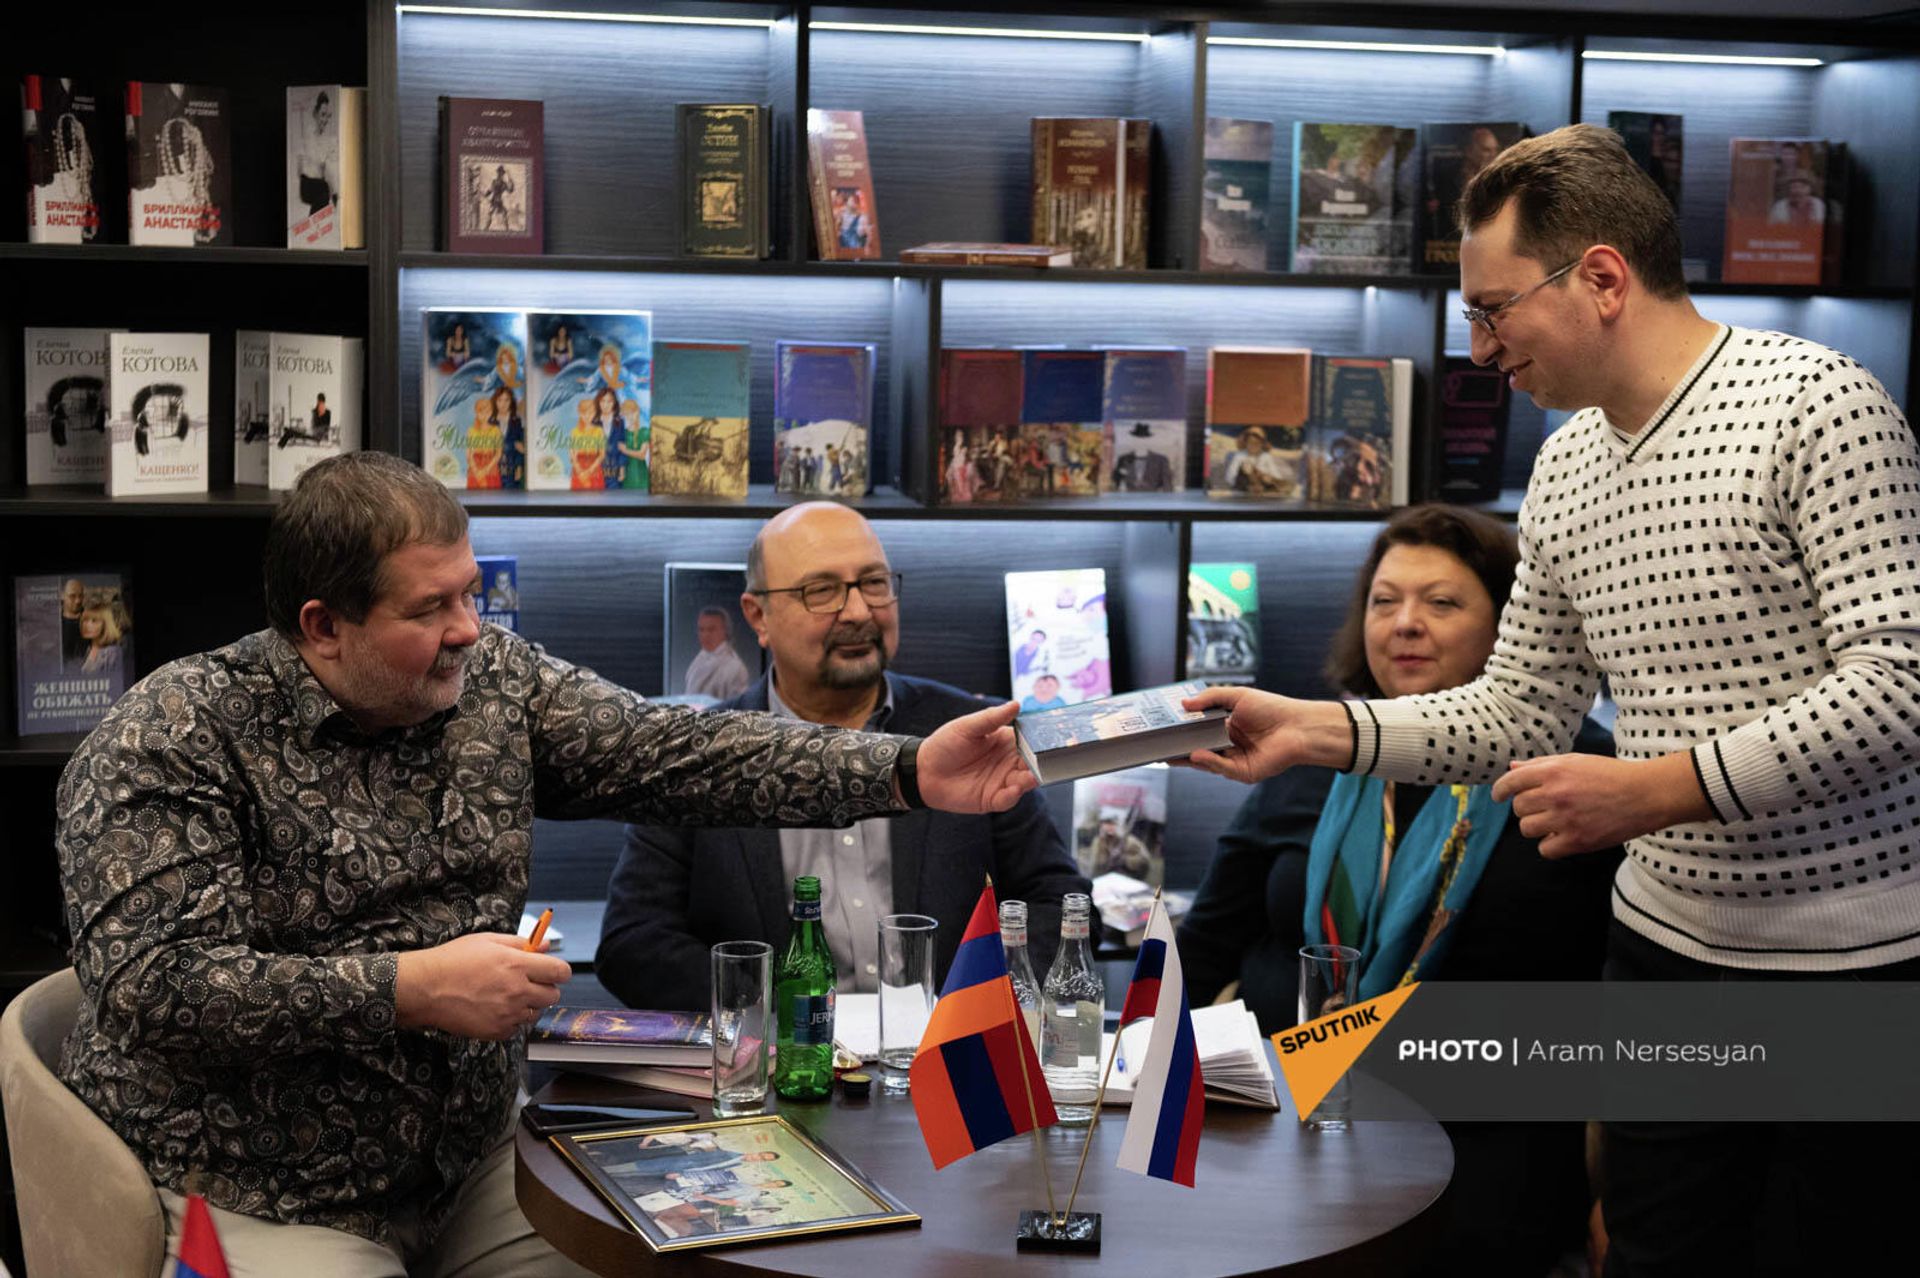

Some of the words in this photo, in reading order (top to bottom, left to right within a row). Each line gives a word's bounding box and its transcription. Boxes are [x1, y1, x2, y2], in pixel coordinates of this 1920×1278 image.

[36, 350, 106, 366] КОТОВ
[121, 356, 199, 373] КОТОВА
[277, 356, 333, 375] КОТОВА
